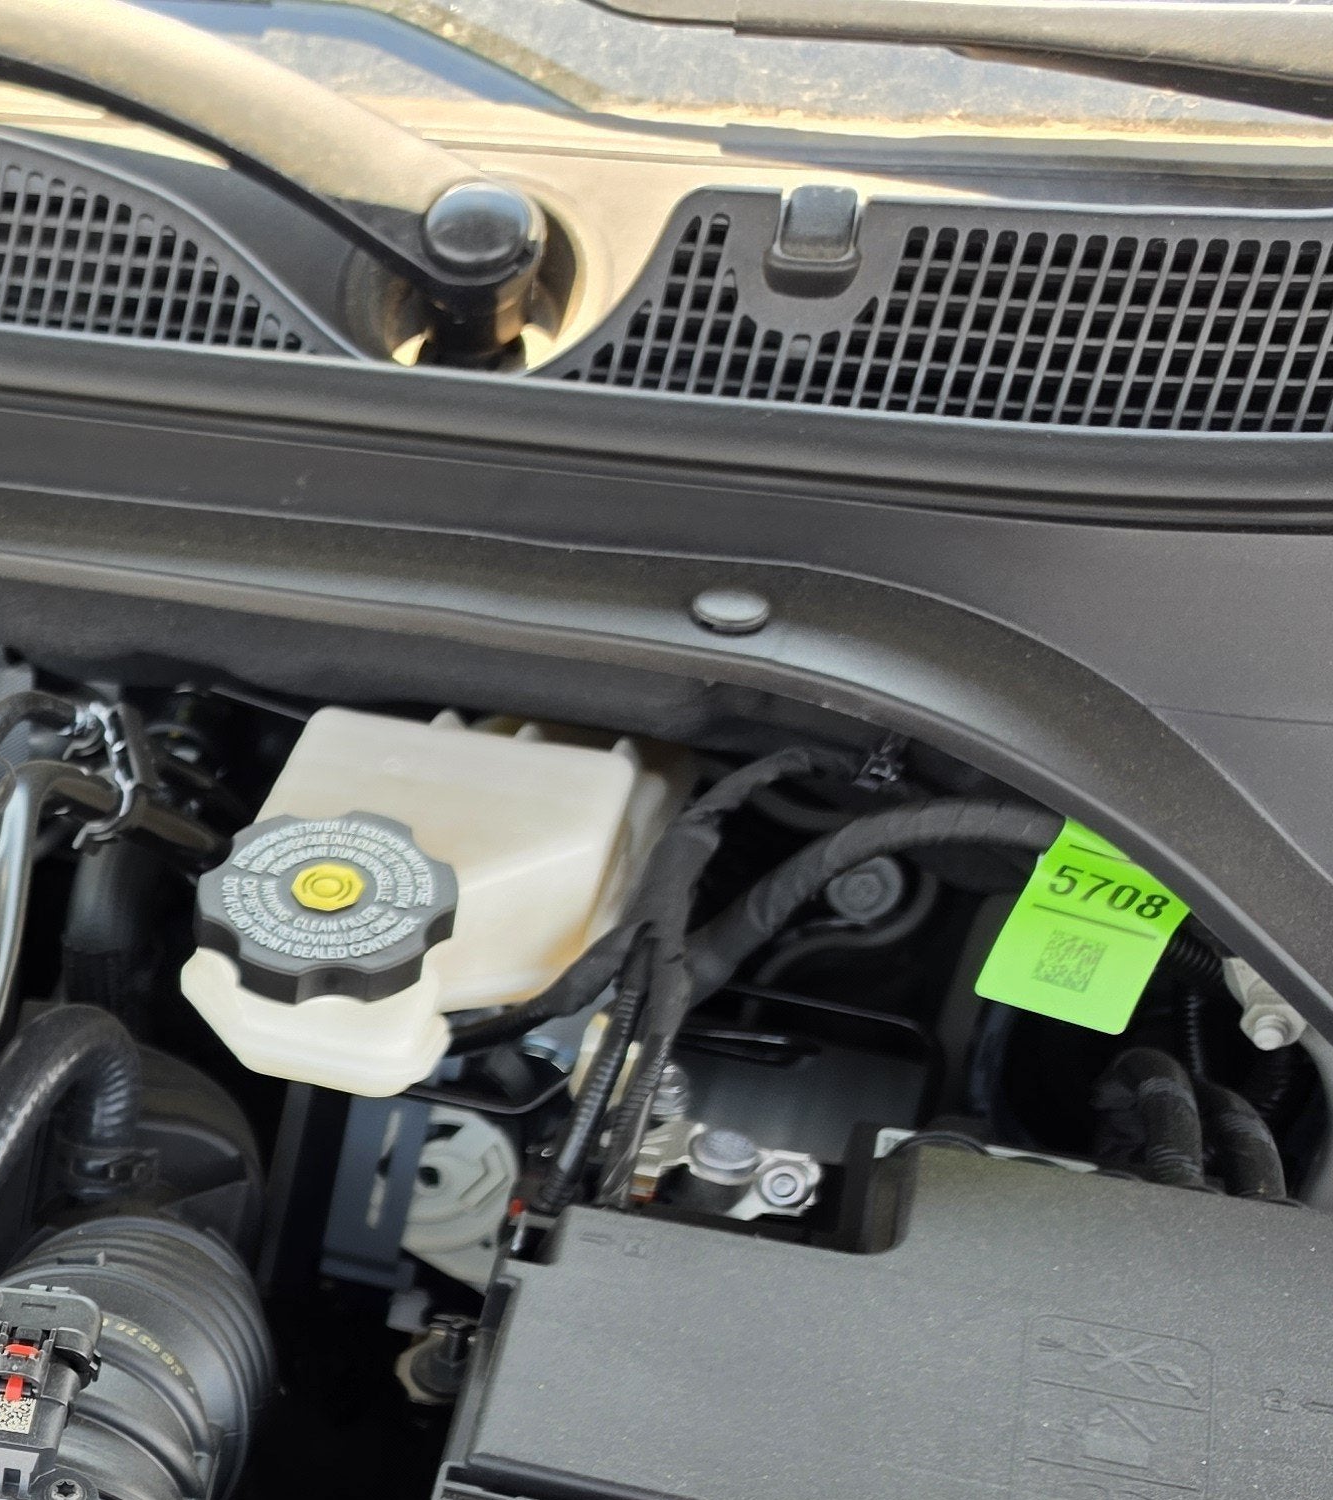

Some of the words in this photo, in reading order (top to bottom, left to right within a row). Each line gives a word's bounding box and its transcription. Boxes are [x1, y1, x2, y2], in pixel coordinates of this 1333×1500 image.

[241, 877, 259, 897] CAP
[1049, 865, 1170, 919] 5708
[223, 901, 253, 930] FLUID
[244, 925, 280, 952] FROM
[279, 941, 293, 955] A
[292, 943, 350, 960] SEALED
[242, 897, 279, 931] BEFORE
[293, 915, 338, 932] CLEAN
[340, 905, 384, 930] FILLER
